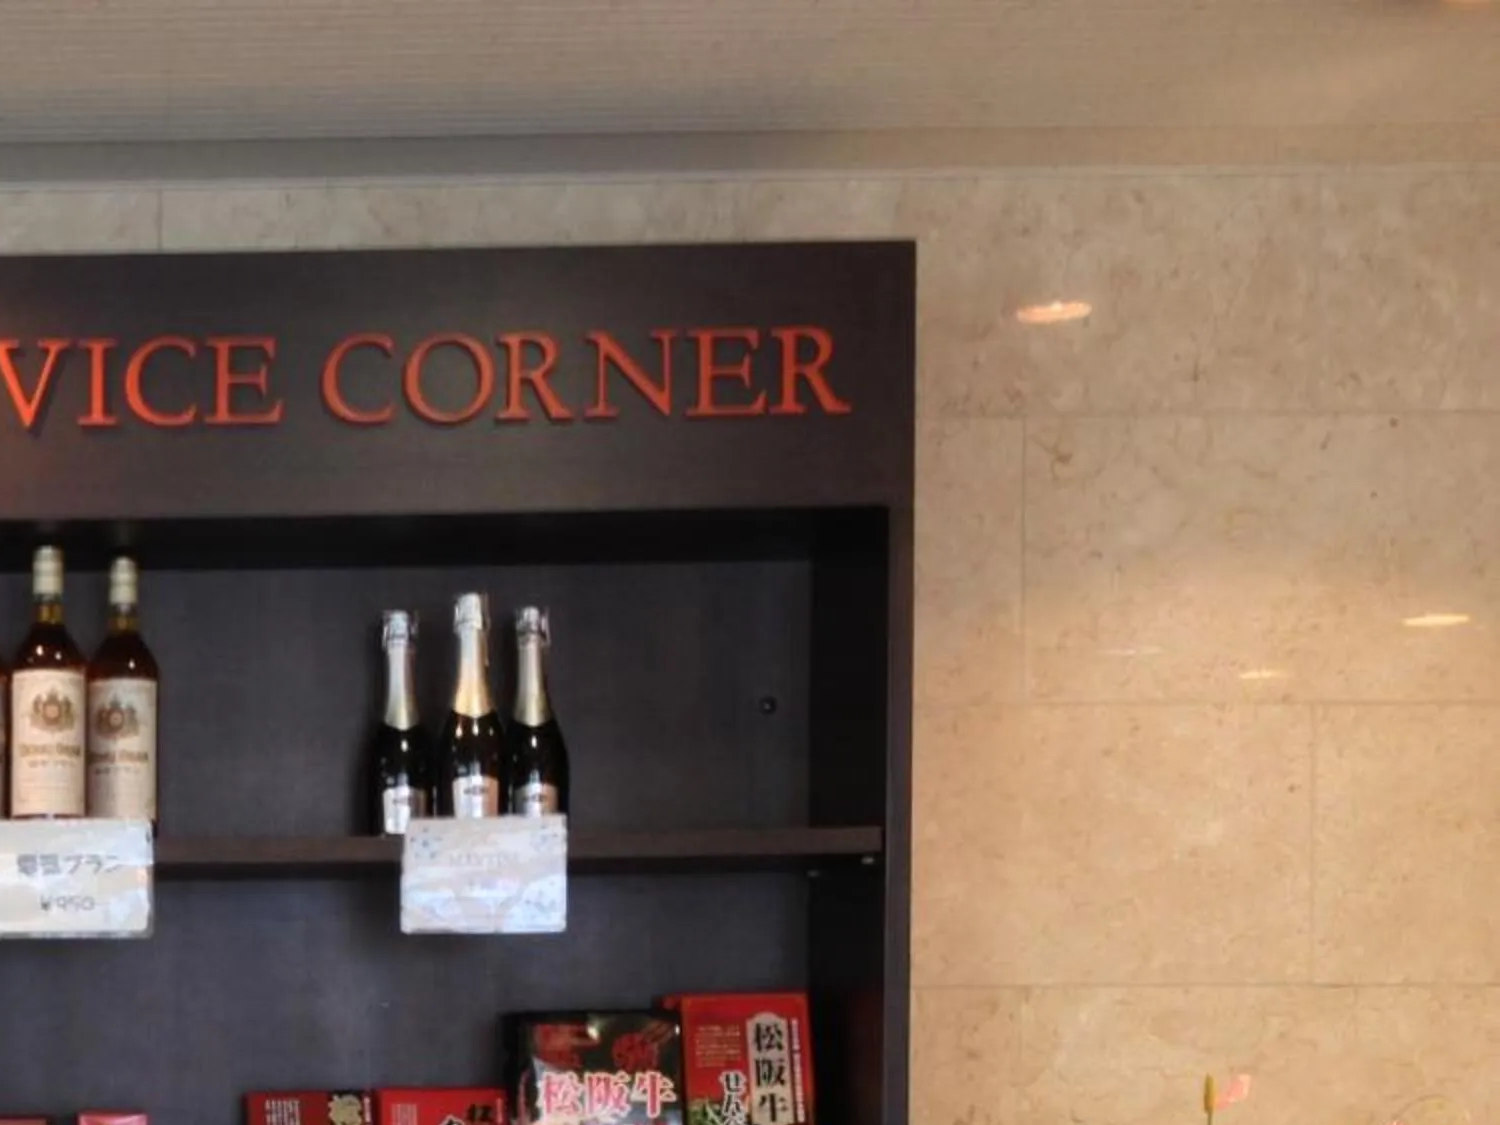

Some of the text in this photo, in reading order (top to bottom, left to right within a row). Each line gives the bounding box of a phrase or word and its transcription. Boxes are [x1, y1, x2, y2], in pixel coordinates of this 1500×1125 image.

[321, 327, 852, 424] CORNER
[538, 1070, 677, 1119] 松阪牛
[753, 1021, 789, 1123] 松阪牛
